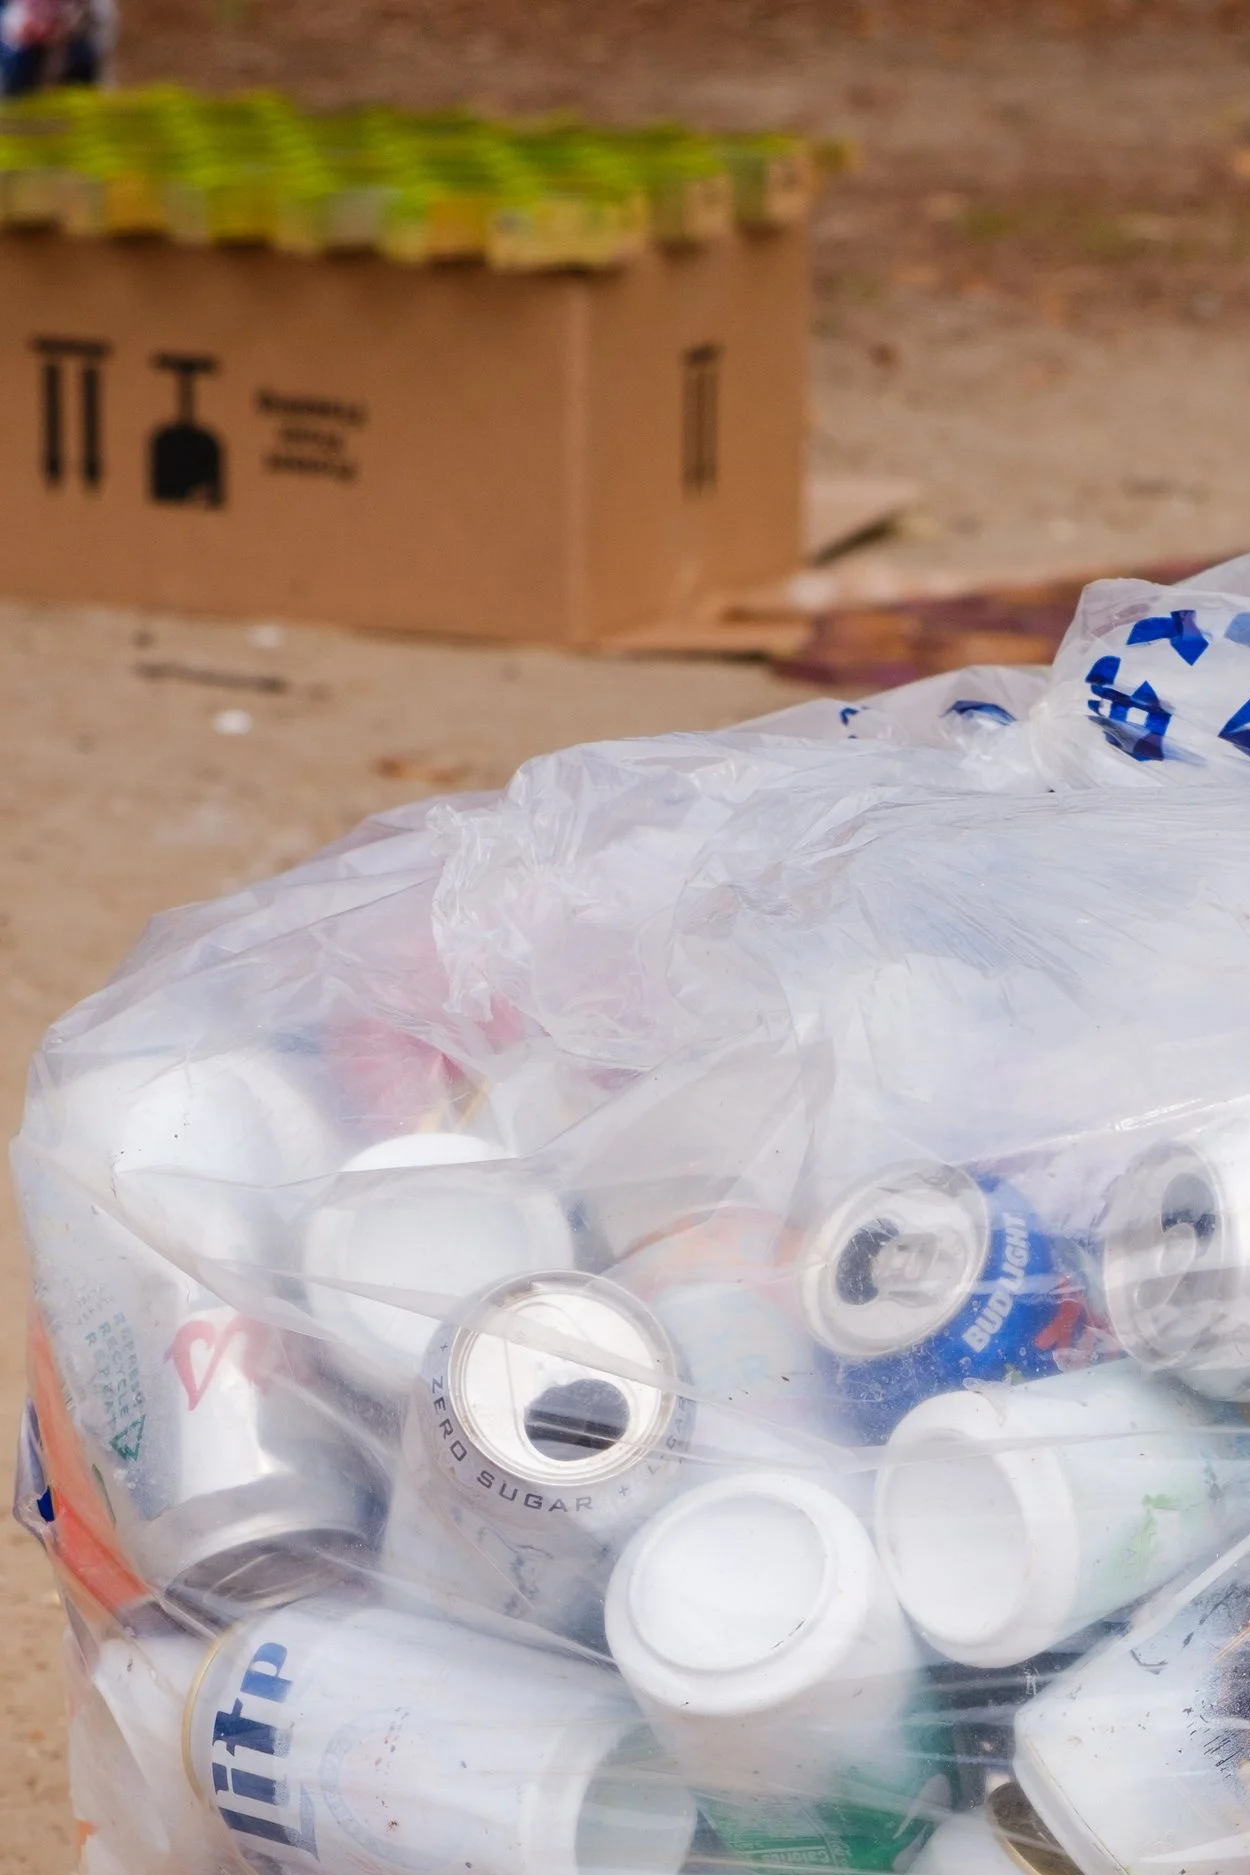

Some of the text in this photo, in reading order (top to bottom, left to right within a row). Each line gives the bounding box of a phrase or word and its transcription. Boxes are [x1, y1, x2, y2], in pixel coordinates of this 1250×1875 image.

[961, 1213, 1032, 1352] BUD LIGHT
[430, 1375, 594, 1513] ZERO SUGAR
